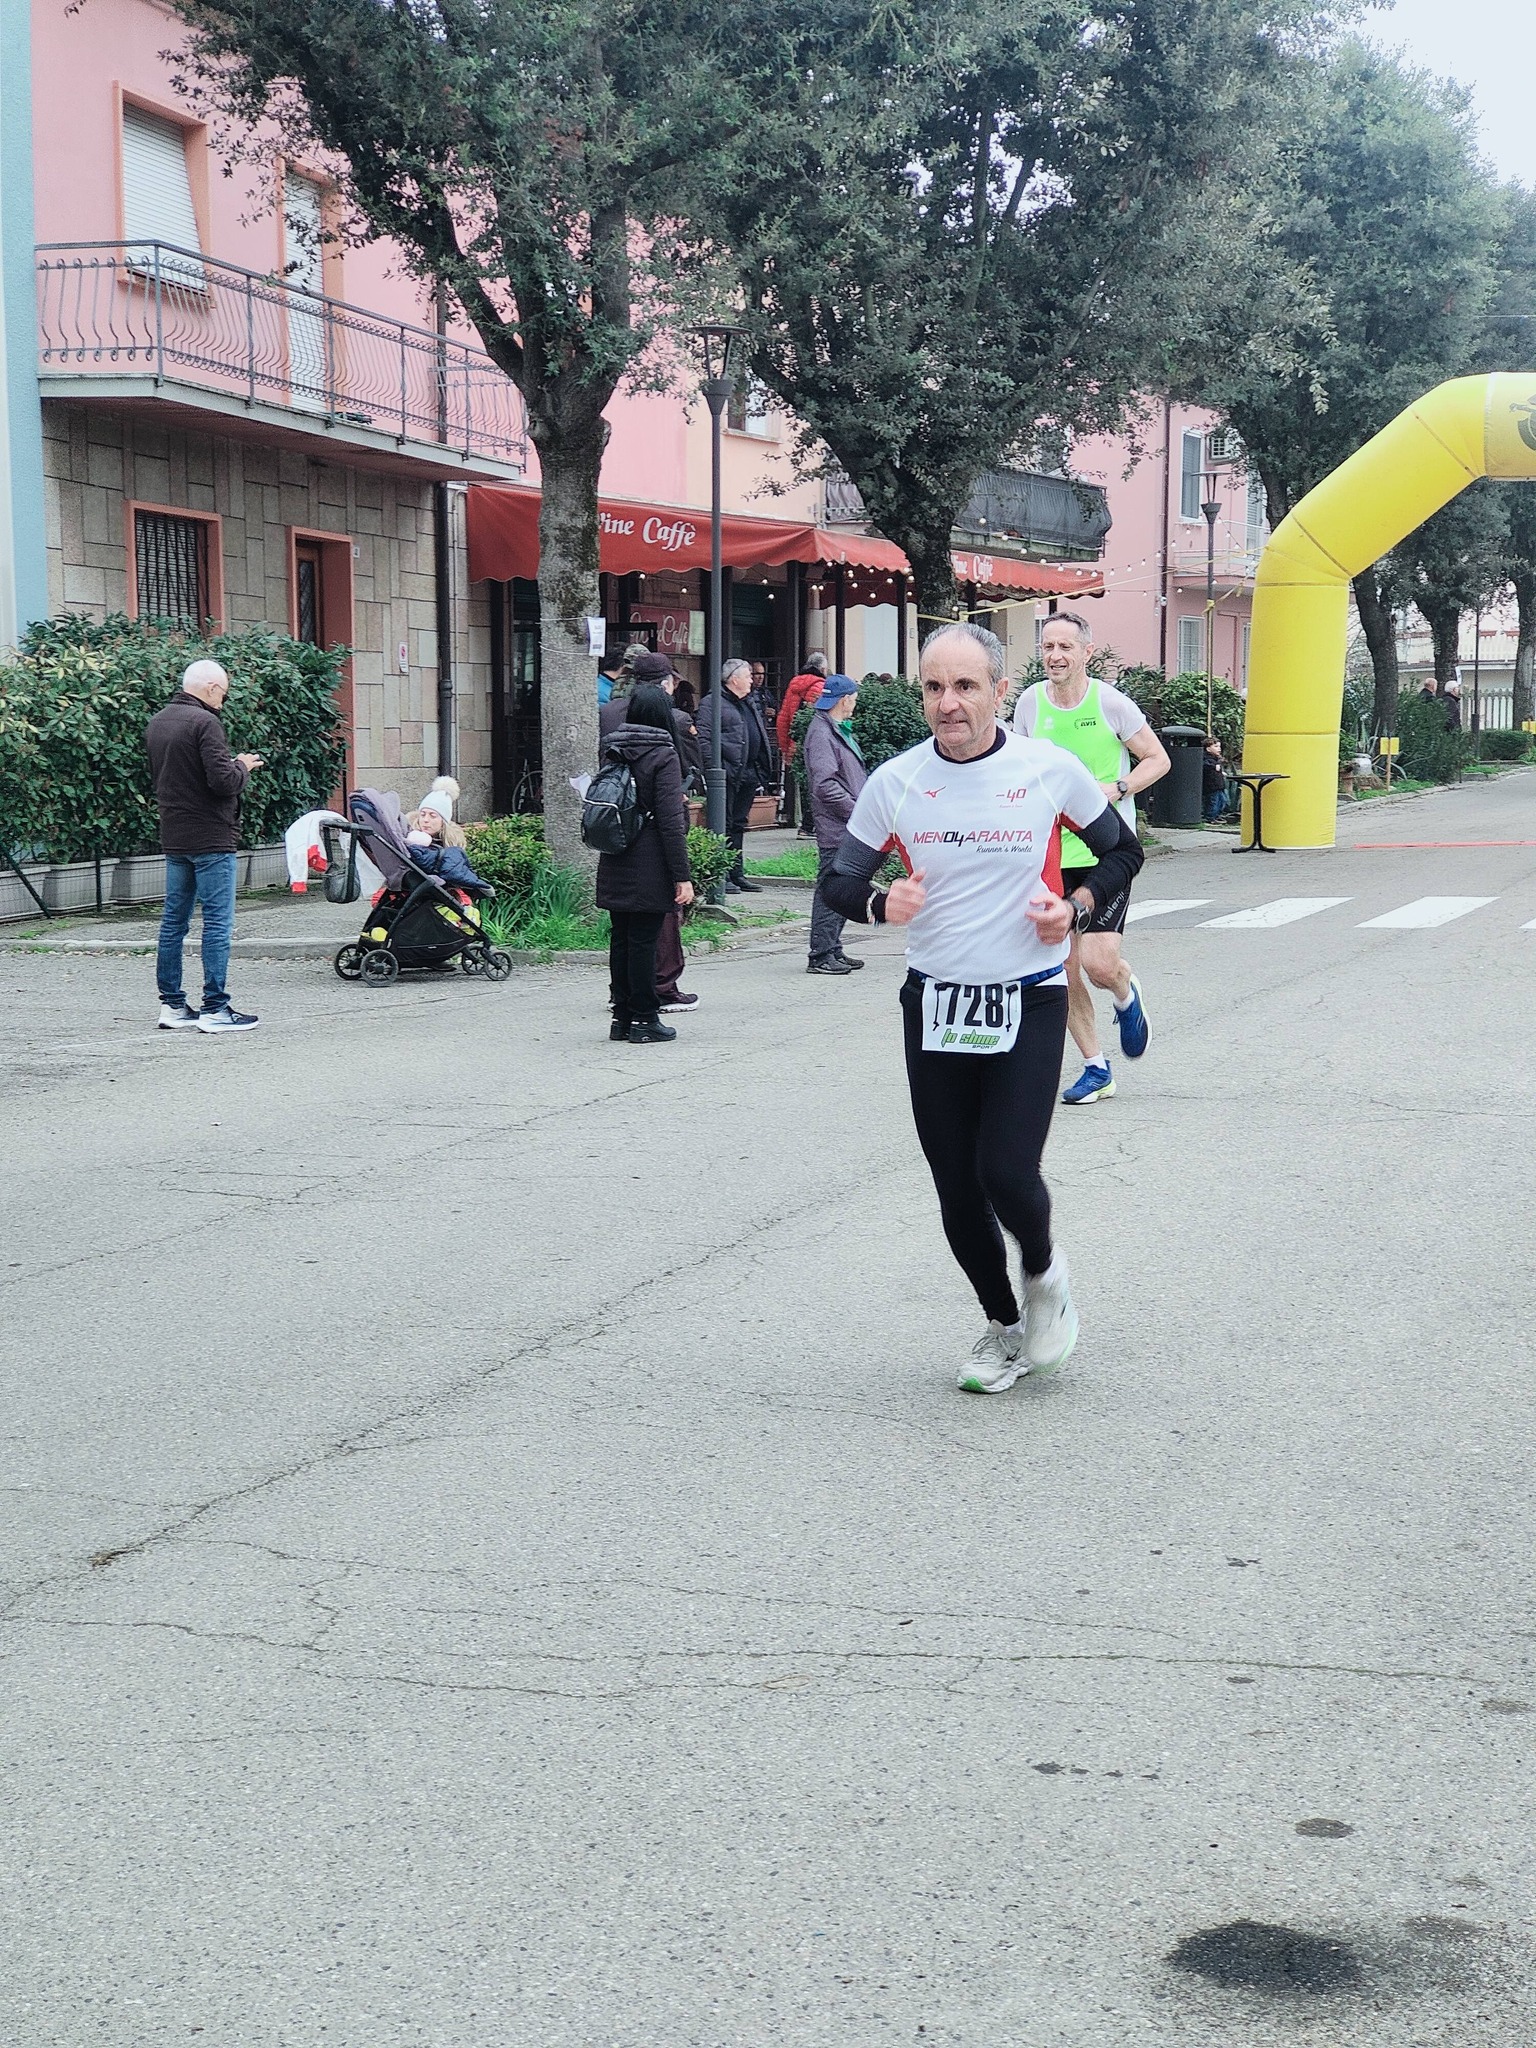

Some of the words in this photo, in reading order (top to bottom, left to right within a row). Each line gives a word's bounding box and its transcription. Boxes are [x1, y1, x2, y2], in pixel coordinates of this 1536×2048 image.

[600, 512, 635, 535] ine
[642, 517, 696, 552] Caffè
[976, 844, 1009, 853] Runner's
[1010, 844, 1033, 853] World
[943, 982, 1004, 1028] 728
